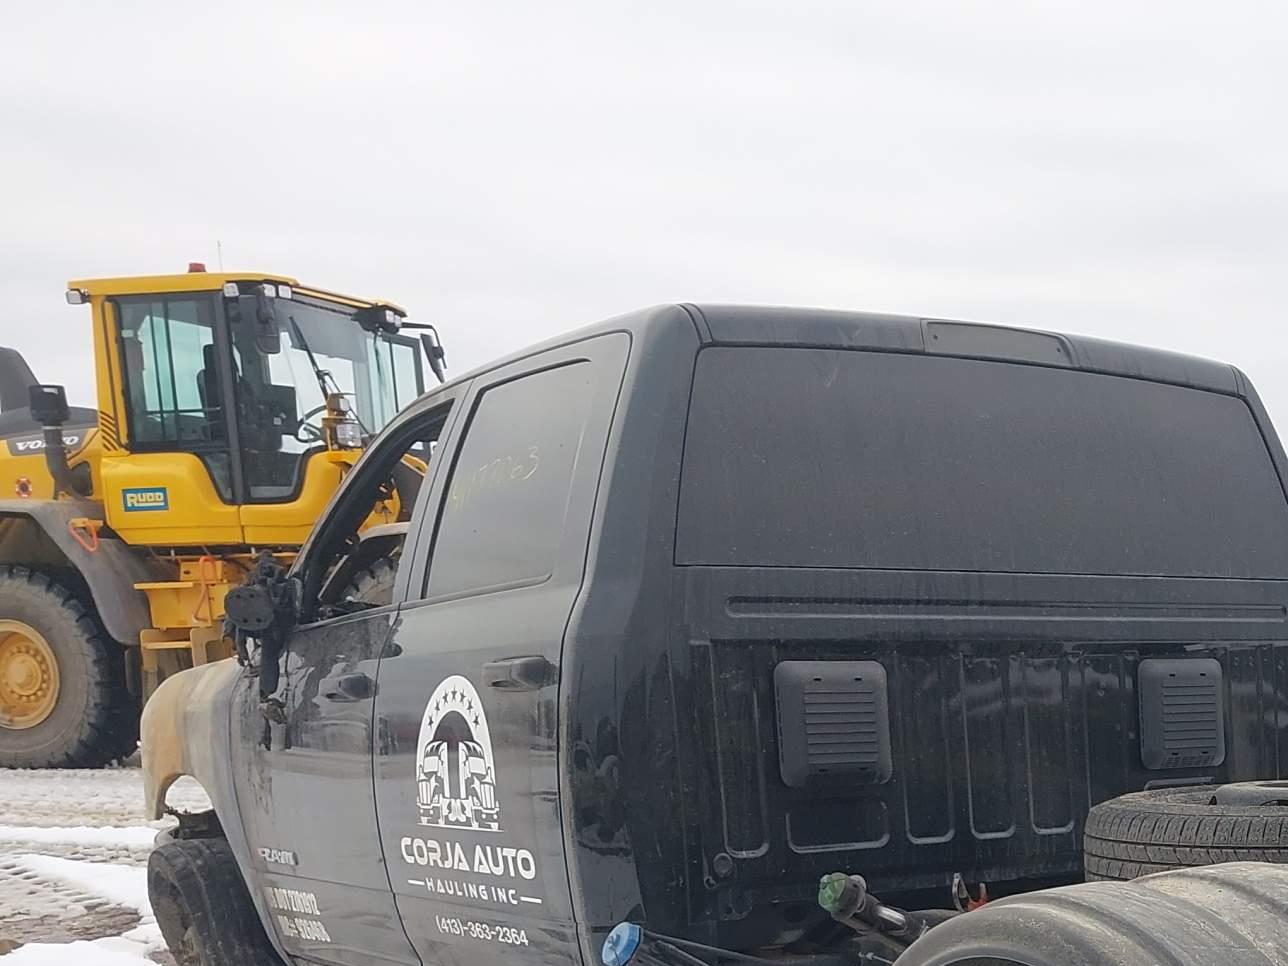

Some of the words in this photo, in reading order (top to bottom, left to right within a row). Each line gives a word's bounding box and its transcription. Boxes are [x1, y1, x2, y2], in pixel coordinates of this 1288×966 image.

[16, 435, 79, 451] VOO
[127, 492, 165, 507] RUDD
[258, 847, 296, 866] RAM
[401, 837, 470, 871] CORJA
[474, 844, 536, 880] AUTO
[425, 877, 488, 900] HAULING
[491, 886, 518, 905] INC
[435, 914, 529, 946] (413)-363-2364
